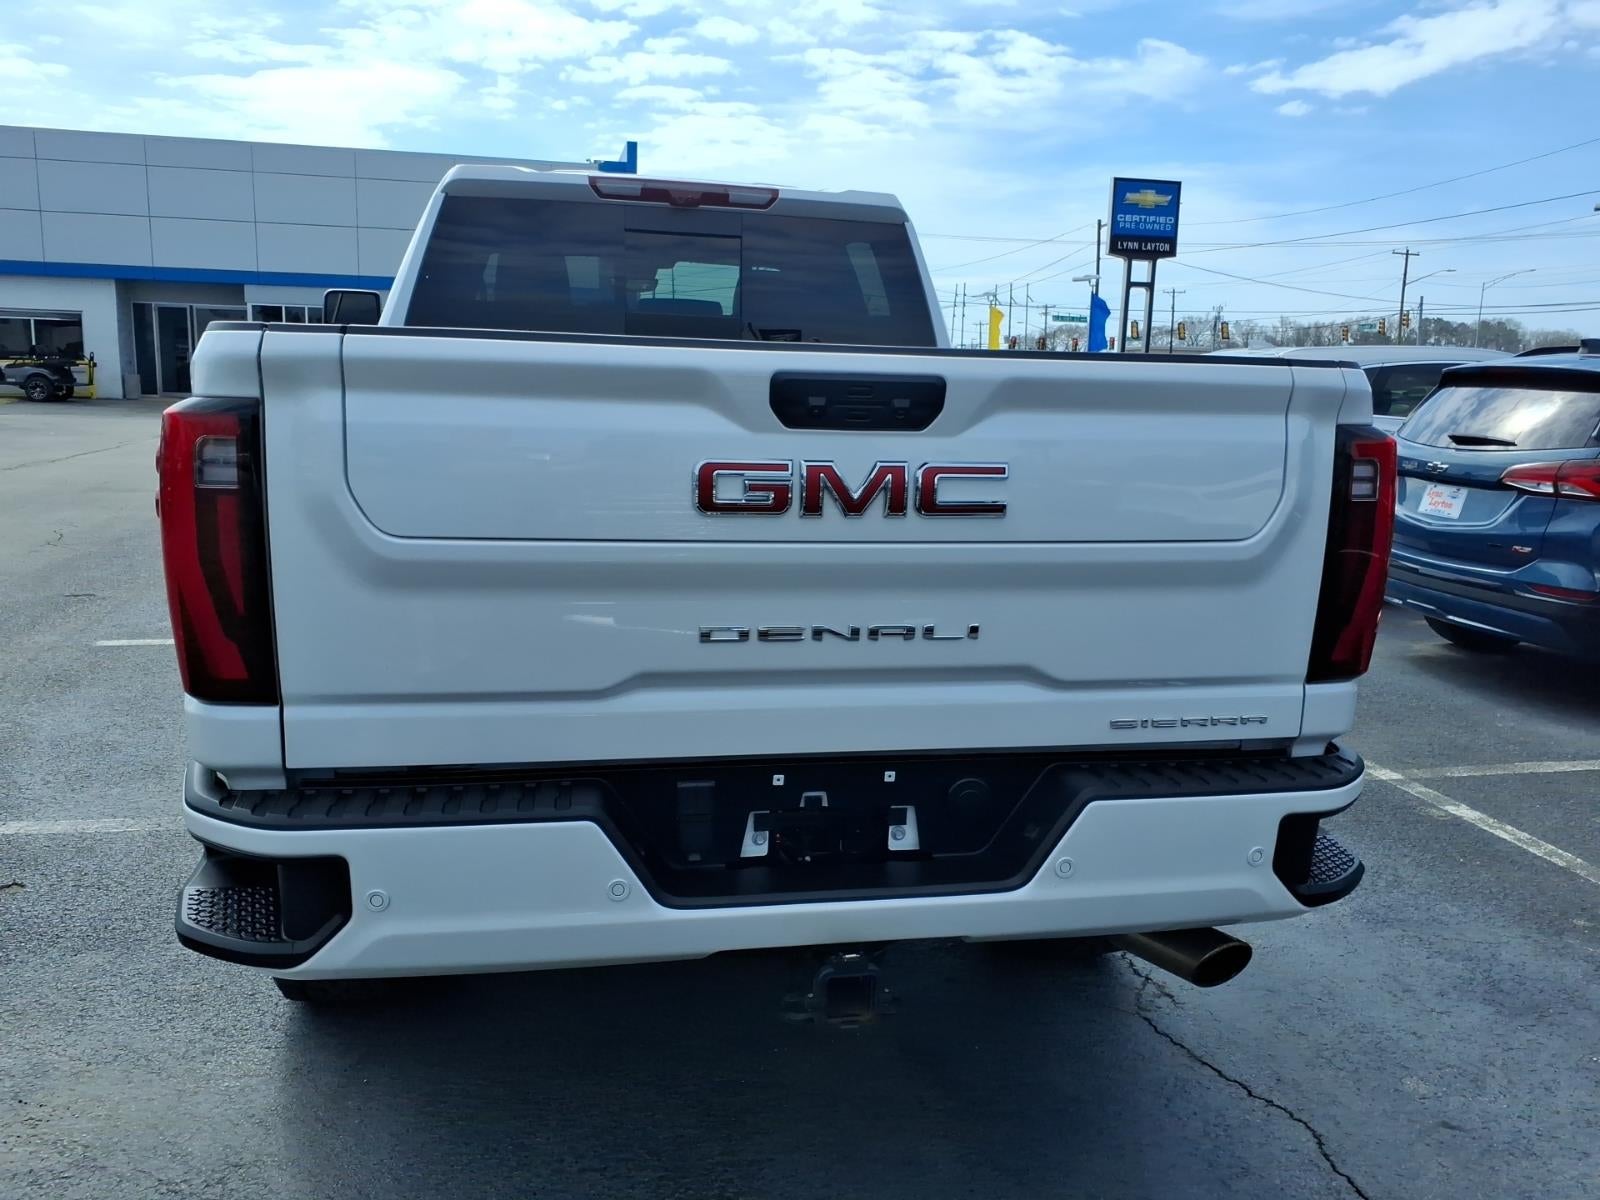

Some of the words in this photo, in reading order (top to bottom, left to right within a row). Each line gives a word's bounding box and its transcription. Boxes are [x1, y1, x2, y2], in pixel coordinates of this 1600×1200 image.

[1117, 214, 1174, 224] CERTIFIED
[1117, 241, 1139, 250] LYNN
[1141, 242, 1170, 252] LAYTON
[692, 459, 1009, 518] GMC
[699, 623, 980, 642] DENALI
[1109, 714, 1268, 730] SIERRA
